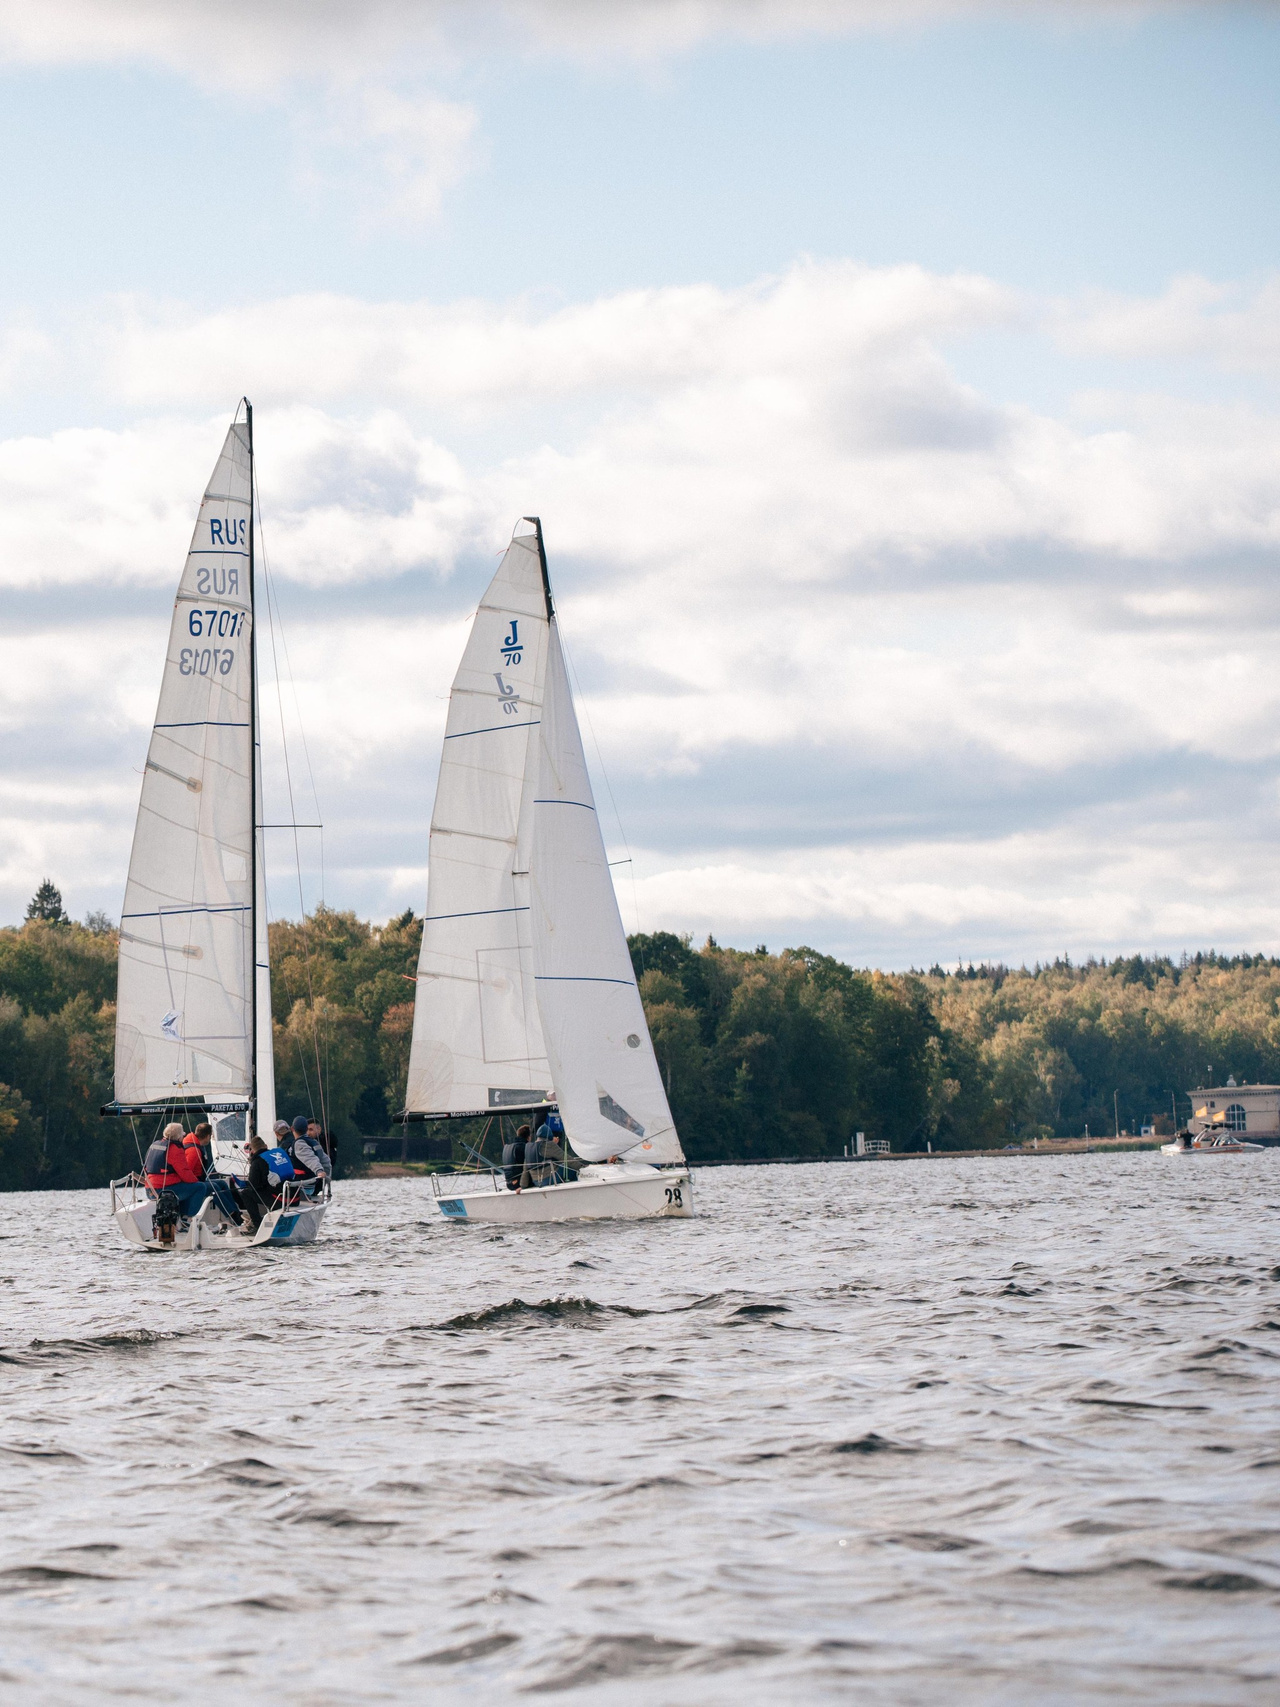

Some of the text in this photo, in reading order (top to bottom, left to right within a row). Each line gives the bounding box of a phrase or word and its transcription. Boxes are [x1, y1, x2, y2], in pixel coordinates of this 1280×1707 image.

[210, 518, 246, 546] RUS
[504, 620, 518, 646] J
[504, 652, 522, 667] 70
[664, 1188, 683, 1208] 28
